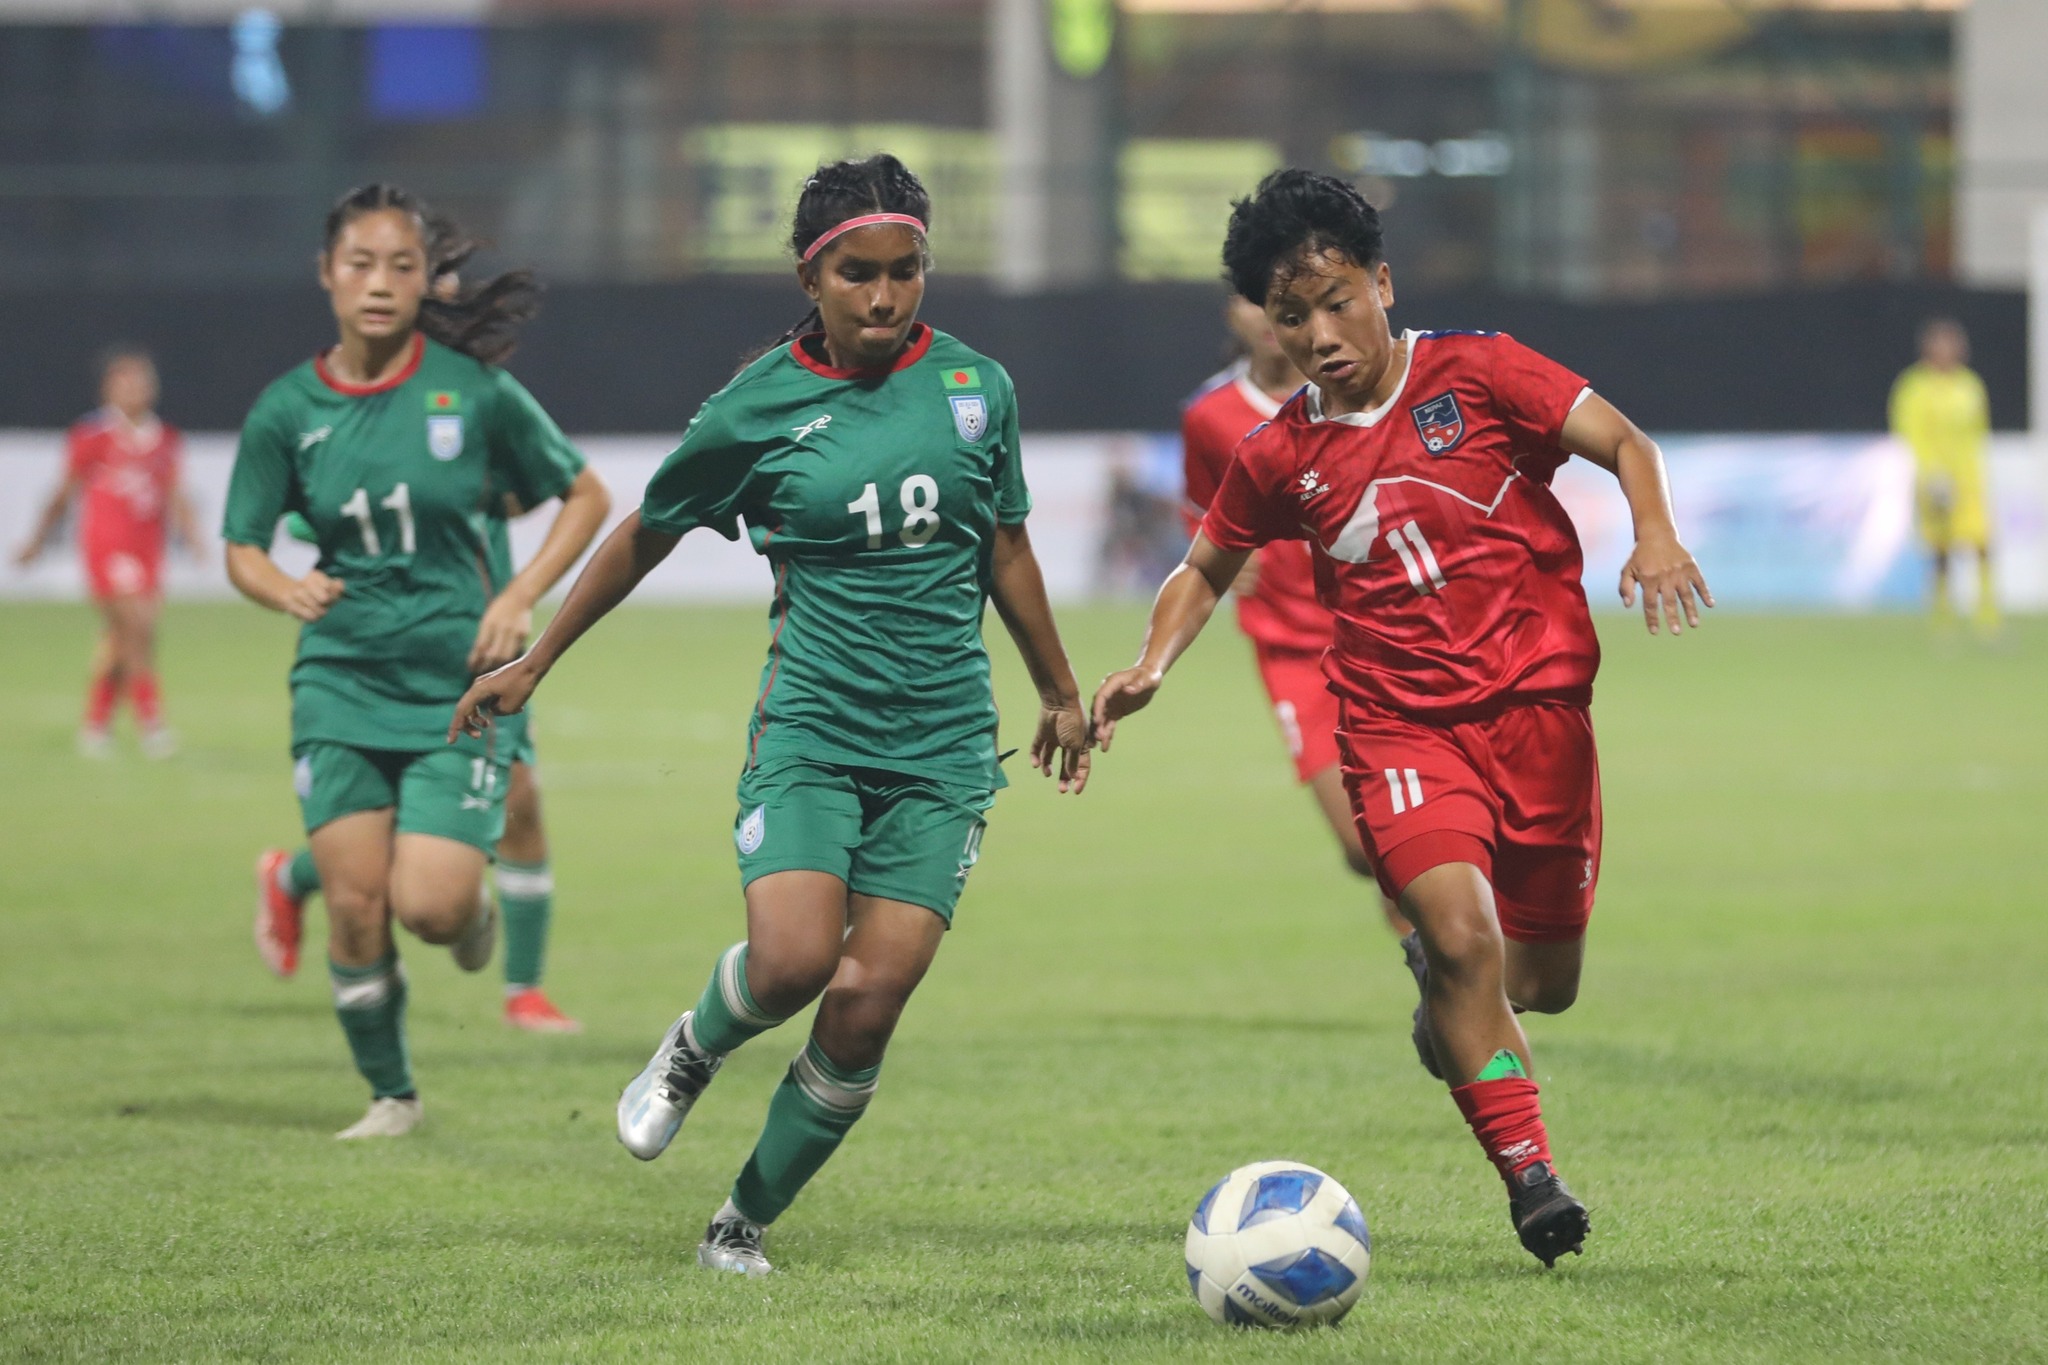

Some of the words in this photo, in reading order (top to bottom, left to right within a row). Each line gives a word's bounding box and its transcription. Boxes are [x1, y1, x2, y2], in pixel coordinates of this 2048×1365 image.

[341, 482, 417, 557] 11
[847, 473, 940, 550] 18
[1385, 519, 1447, 596] 11
[471, 757, 496, 795] 11
[1384, 768, 1424, 815] 11
[1237, 1284, 1300, 1326] molten
